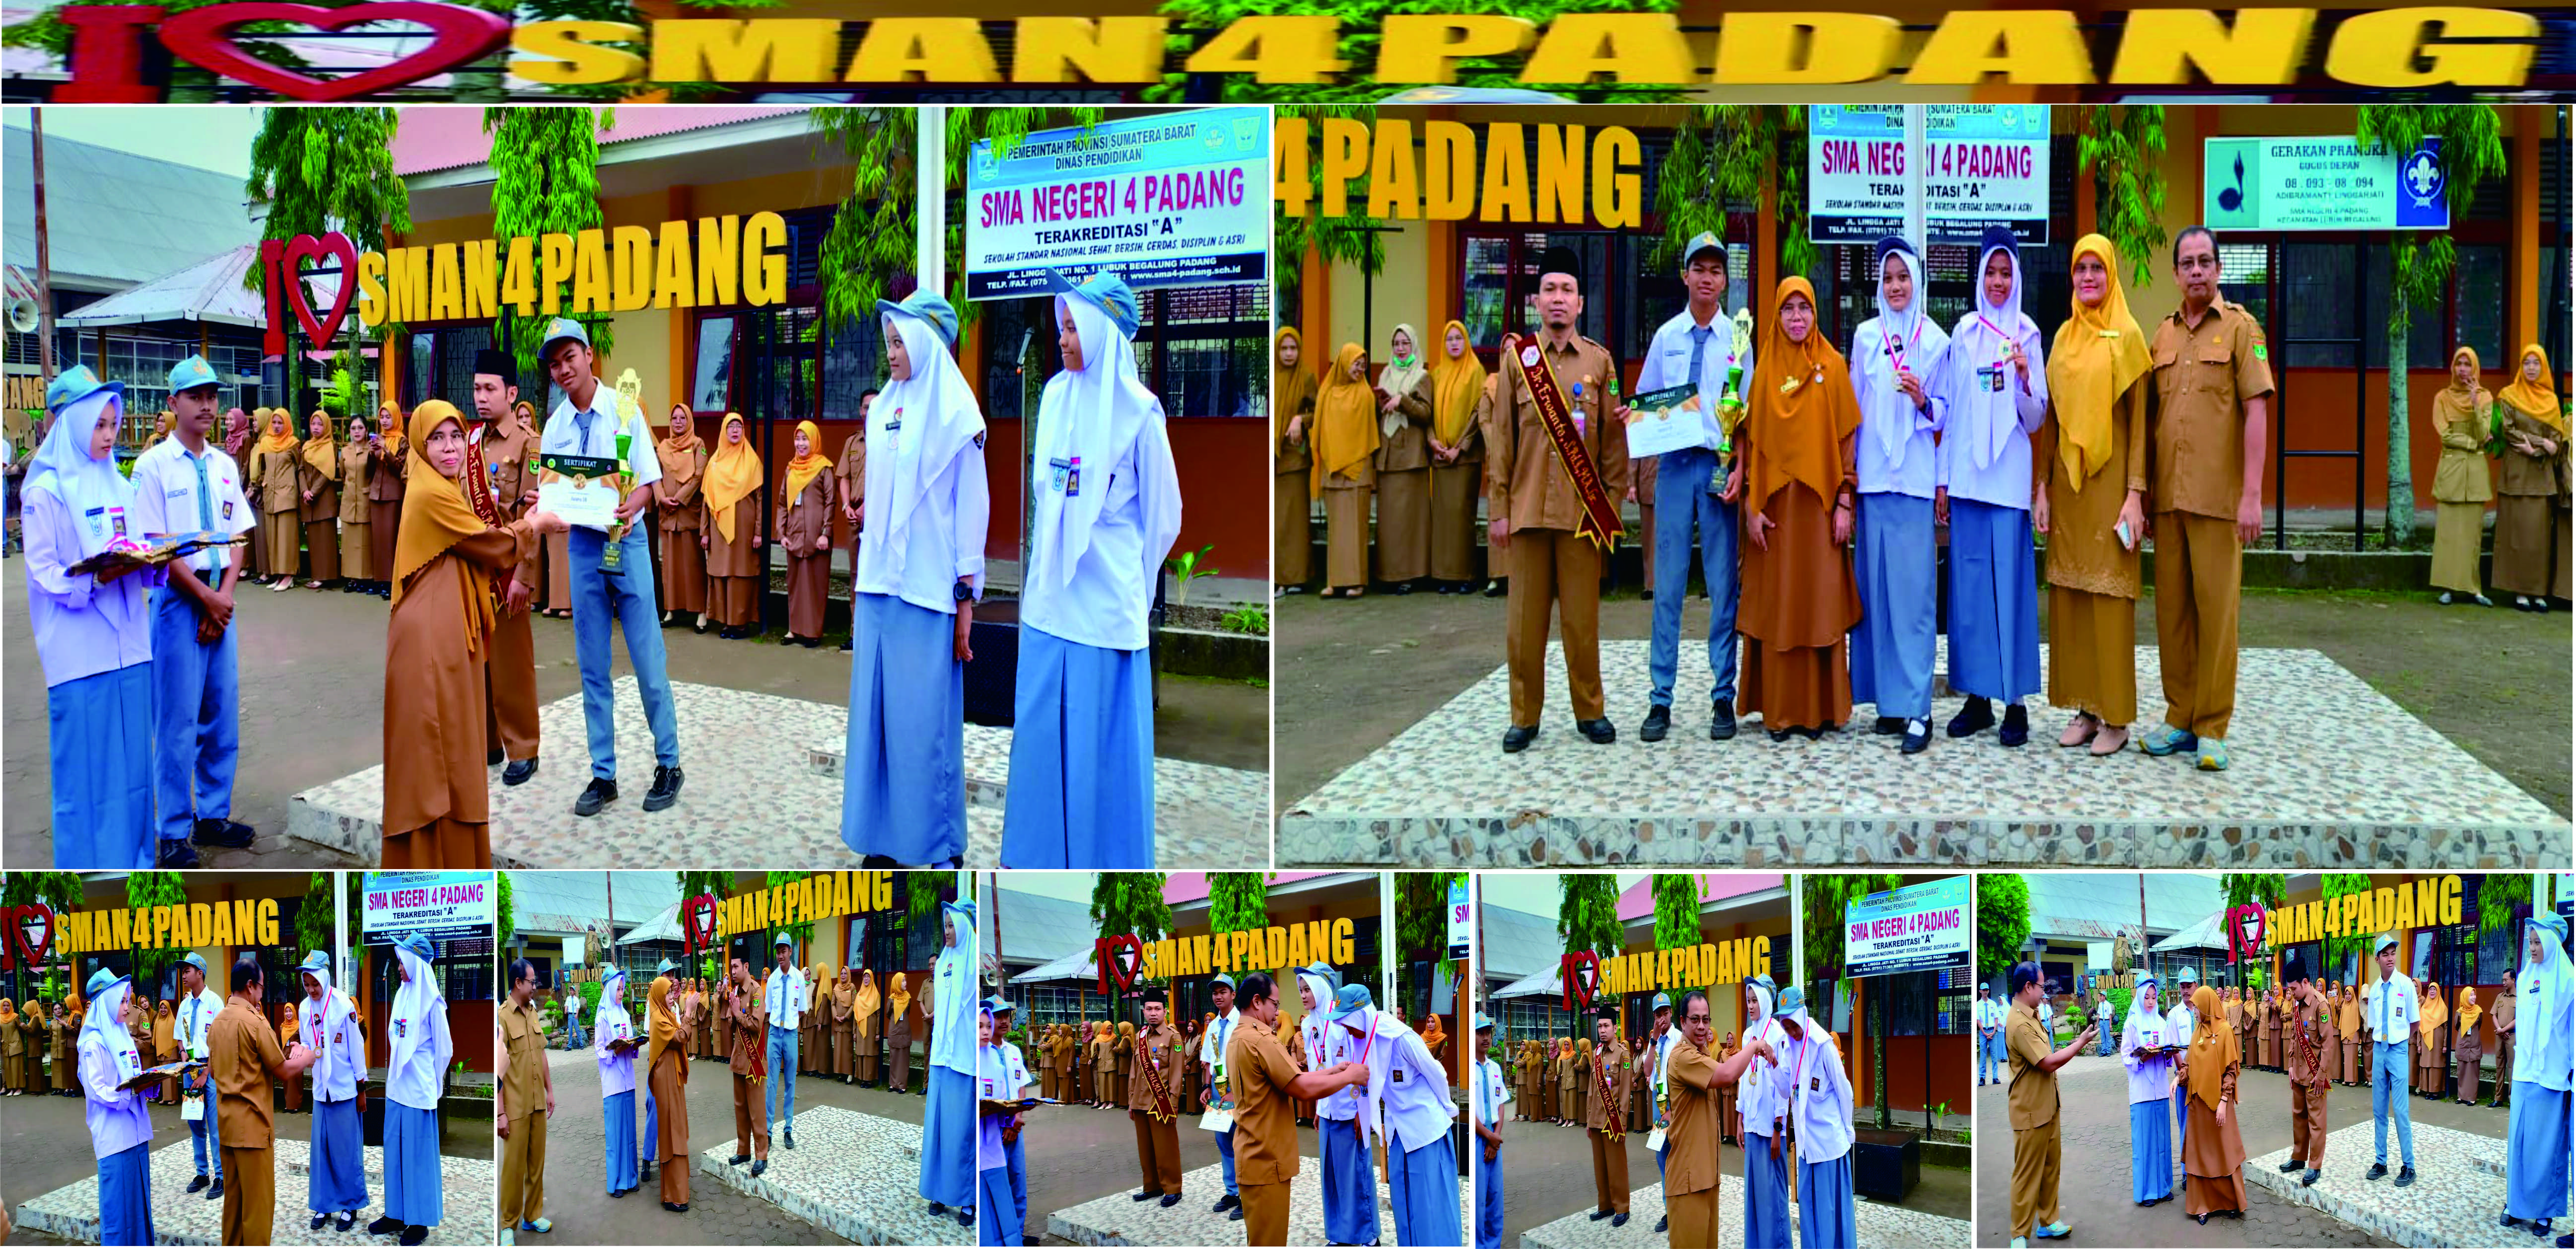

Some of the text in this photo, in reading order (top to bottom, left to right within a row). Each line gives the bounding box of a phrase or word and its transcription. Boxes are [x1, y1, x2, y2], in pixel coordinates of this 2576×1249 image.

[1886, 116, 1903, 128] DINA
[1008, 124, 1196, 160] PEMERINTAH PROVINSI SUMATERA BARAT
[2272, 146, 2326, 157] GERAKAN
[1055, 148, 1142, 170] DINAS PENDIDIKAN
[1822, 140, 2031, 179] SMA NEGI 4 PADANG
[2330, 161, 2360, 169] DEPAN
[981, 167, 1244, 228] SMA NEGERI 4 PADANG
[1035, 223, 1148, 244] TERAKREDITASI
[984, 253, 1015, 264] SEKOLAH
[1016, 250, 1048, 261] STANDAR
[1050, 247, 1086, 259] NASIONAL
[1181, 236, 1216, 248] DISIPLIN
[1226, 234, 1246, 245] ASRI
[358, 211, 788, 327] SMAN4PADANG
[1021, 269, 1046, 278] LINGG
[1129, 259, 1178, 270] BEGALUNG
[1180, 257, 1217, 267] PADANG
[1030, 278, 1047, 287] (075
[1130, 265, 1241, 280] www.sma4-padang.sch.id
[564, 458, 597, 468] SERTIFIKAT
[369, 884, 484, 911] SMA NEGERI 4 PADANG
[1862, 898, 1884, 907] PEMERINTAH
[1903, 890, 1924, 900] SUMATERA
[1926, 887, 1939, 896] BARAT
[1893, 900, 1917, 910] PENDIDIKAN
[393, 909, 442, 919] TERAKREDITASI
[2265, 874, 2463, 947] SMAN4PADANG
[54, 898, 279, 955] SMAN4PADANG
[1851, 908, 1959, 943] SMA NEGERI 4 PADANG
[1142, 918, 1355, 979] SMAN4PADANG
[1873, 937, 1920, 950] TERAKREDITASI
